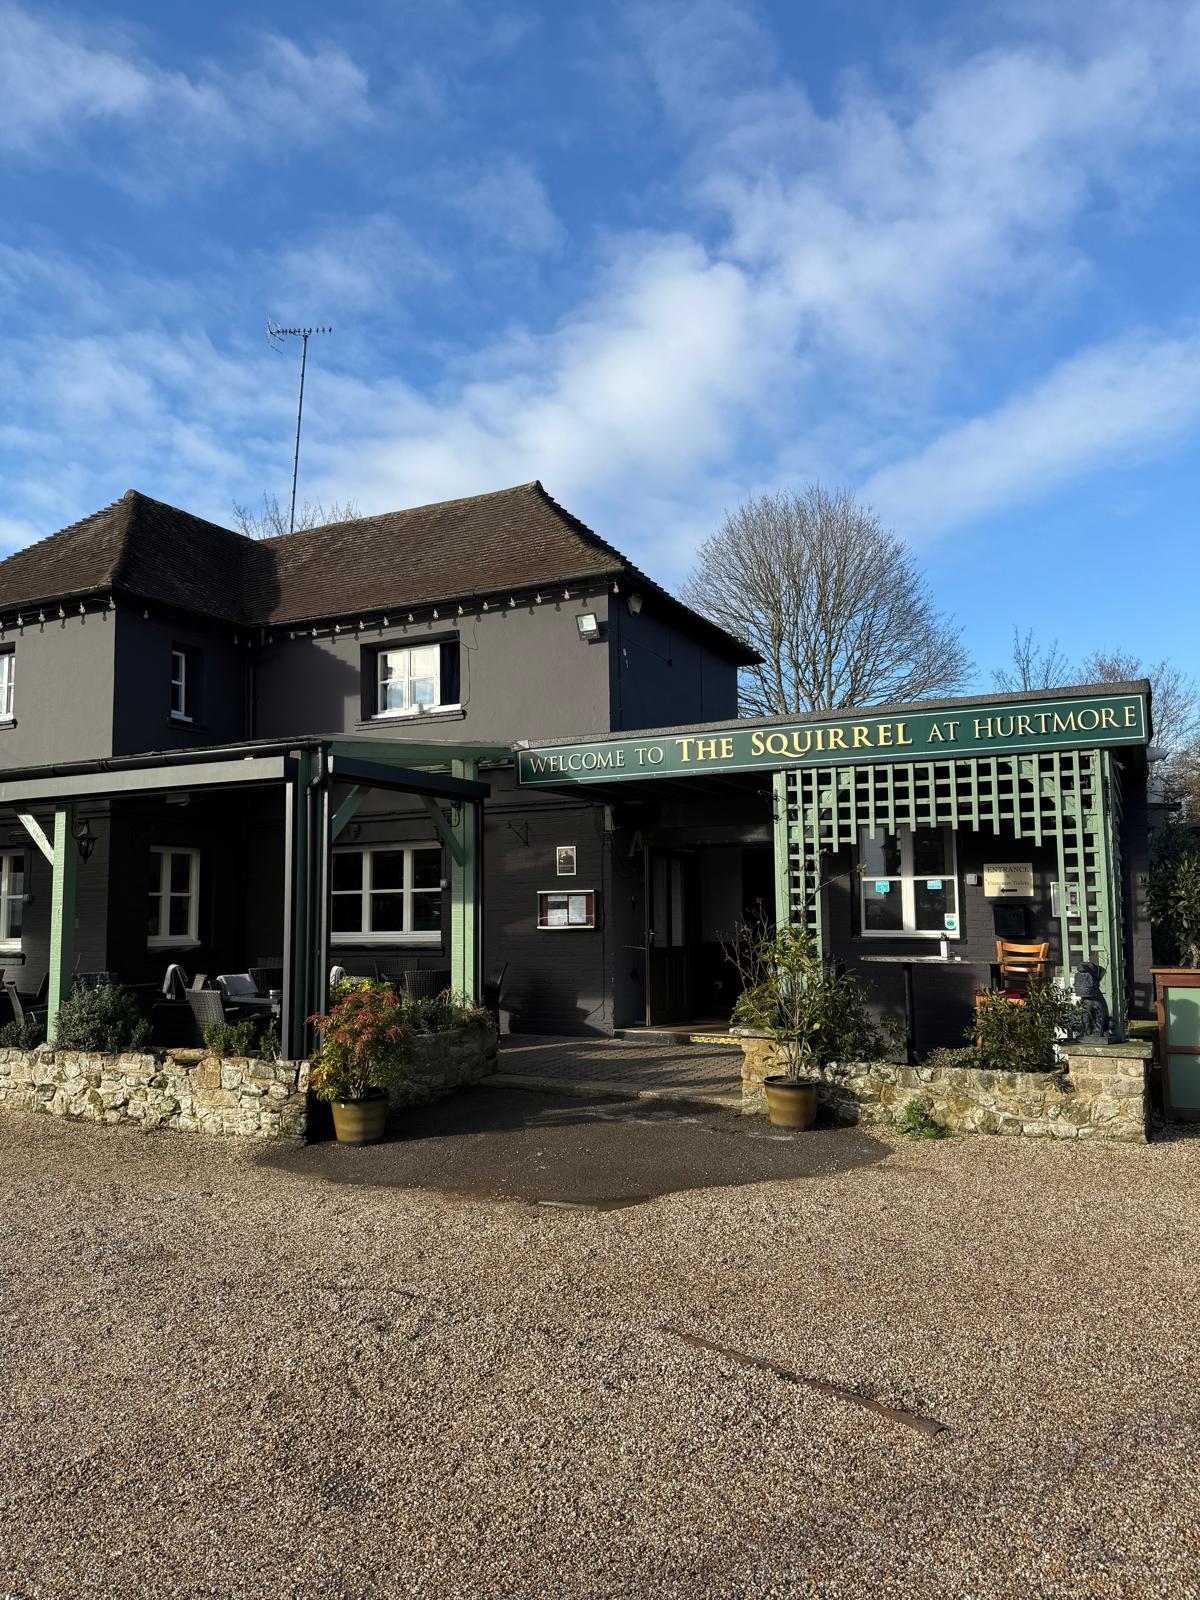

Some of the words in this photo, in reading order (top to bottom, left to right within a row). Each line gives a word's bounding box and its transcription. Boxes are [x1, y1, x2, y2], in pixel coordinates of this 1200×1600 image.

[529, 750, 625, 774] WELCOME
[635, 746, 664, 765] TO
[675, 737, 734, 762] THE
[751, 722, 912, 758] SQUIRREL
[927, 721, 960, 742] AT
[973, 706, 1137, 739] HURTMORE
